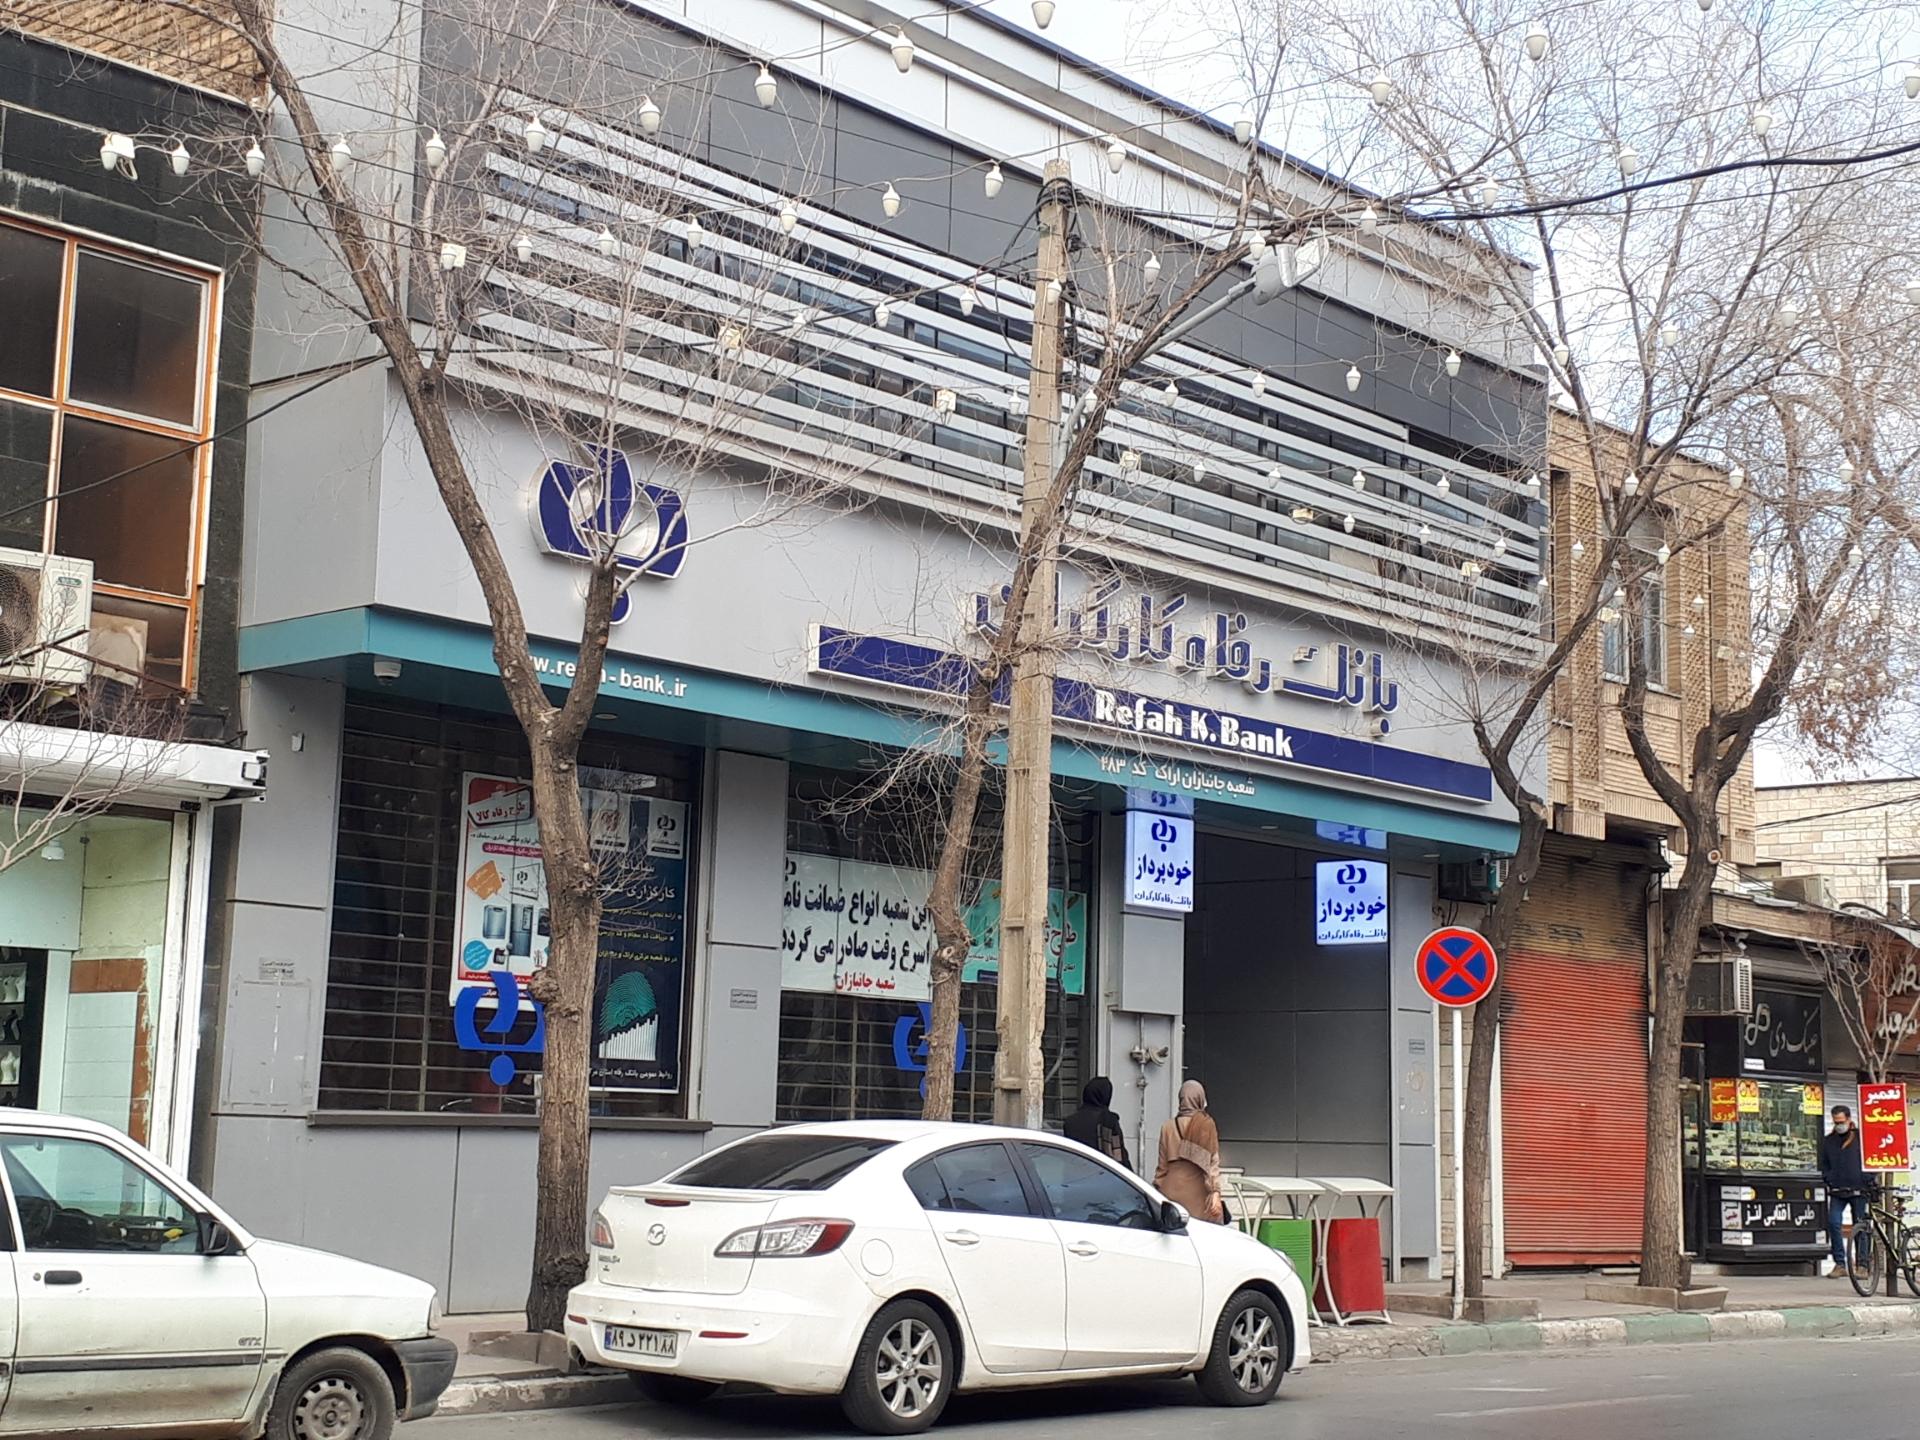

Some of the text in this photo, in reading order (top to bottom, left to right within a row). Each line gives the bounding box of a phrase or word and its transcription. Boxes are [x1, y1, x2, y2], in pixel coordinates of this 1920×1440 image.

[1186, 611, 1272, 694] رفاه
[1095, 690, 1183, 737] Refah
[1131, 760, 1148, 776] کد
[1155, 763, 1180, 787] اراک
[1182, 770, 1226, 795] جانبازان
[1227, 776, 1255, 798] شعبه
[626, 884, 676, 903] کارگزاری
[804, 883, 846, 914] ضمانت
[848, 889, 880, 926] انواع
[882, 896, 910, 927] شعبه
[814, 938, 834, 963] می
[836, 930, 868, 966] صادر
[871, 932, 897, 970] وقت
[899, 940, 931, 972] اسرع
[836, 970, 896, 994] شعبه جانبازان
[1786, 1006, 1819, 1066] عینک
[1711, 1094, 1736, 1107] عینک
[1864, 1085, 1901, 1105] تعمیر
[1864, 1107, 1904, 1126] عینک
[1878, 1133, 1894, 1149] در
[1744, 1203, 1762, 1226] لنز
[1794, 1204, 1816, 1227] طبی
[611, 1329, 625, 1348] ۸۹
[660, 1338, 675, 1354] ۸۸
